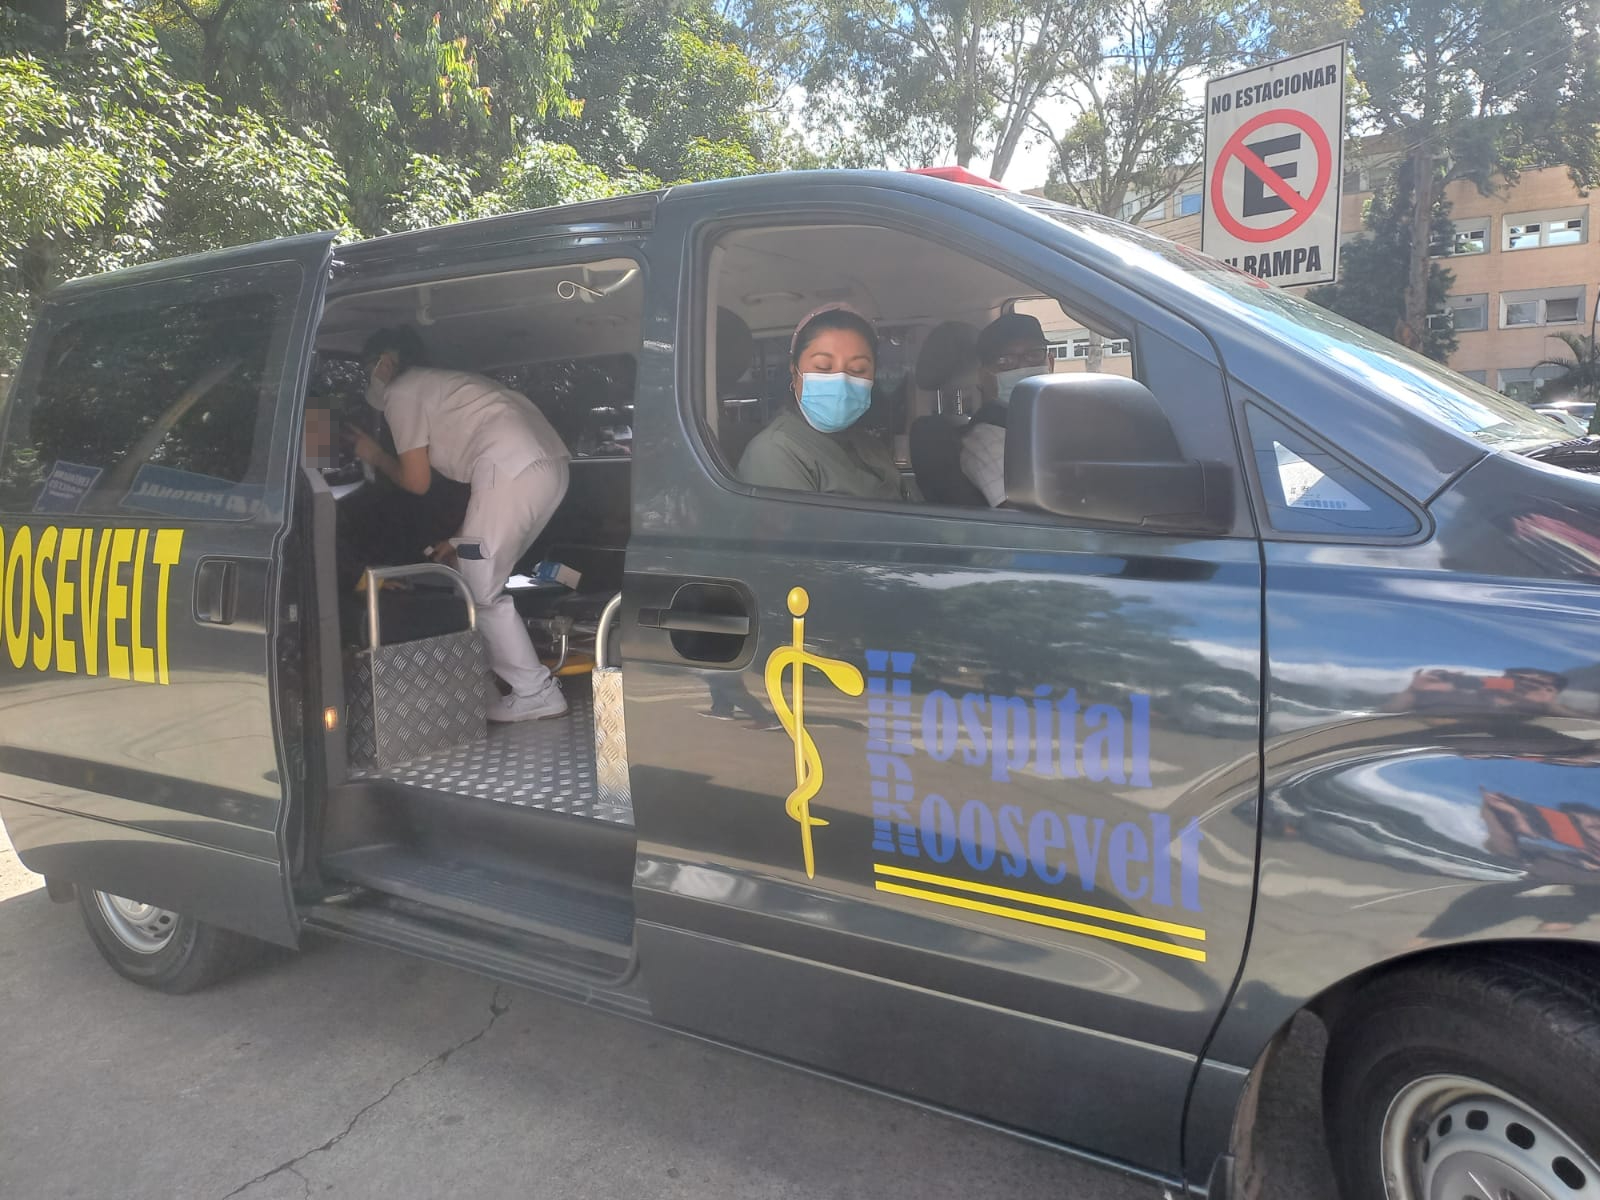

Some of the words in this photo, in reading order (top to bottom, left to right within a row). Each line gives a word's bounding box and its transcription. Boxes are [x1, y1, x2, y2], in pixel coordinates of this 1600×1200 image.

[1211, 93, 1232, 115] NO
[1235, 64, 1337, 109] ESTACIONAR
[1243, 133, 1302, 217] E
[1243, 245, 1322, 279] RAMPA
[0, 525, 184, 685] OSEVELT
[865, 649, 1153, 788] Hospital
[866, 753, 1204, 913] Roosevelt
